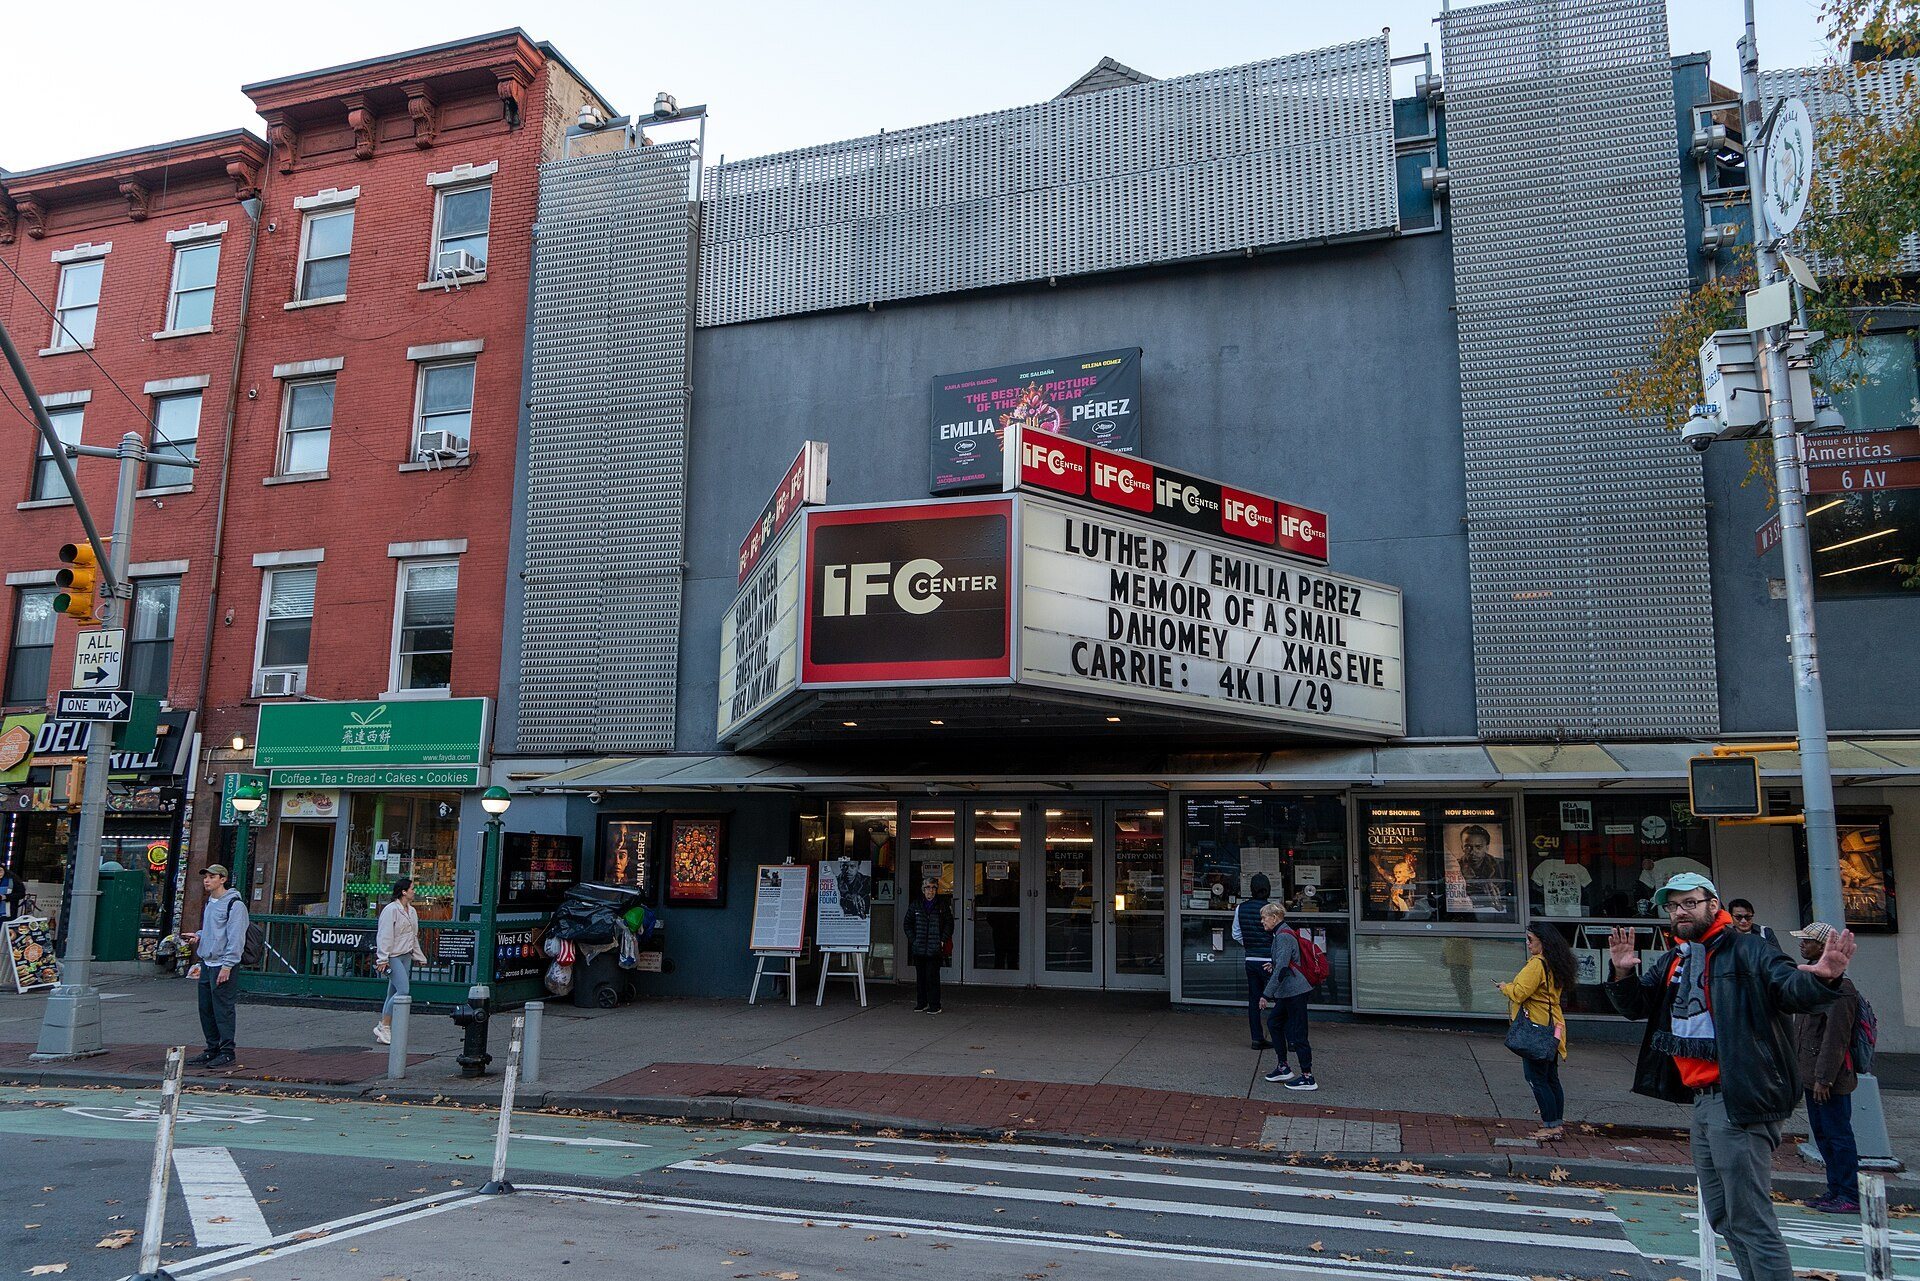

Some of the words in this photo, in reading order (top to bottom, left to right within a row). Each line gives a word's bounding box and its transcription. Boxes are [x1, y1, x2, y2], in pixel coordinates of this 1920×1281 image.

[1082, 362, 1102, 370] SELENA
[1030, 369, 1055, 378] SALDAÑA
[944, 383, 961, 391] KARLA
[976, 378, 998, 387] GASCÓN
[991, 387, 1022, 399] BEST
[1045, 376, 1097, 392] PICTURE
[976, 404, 990, 412] OF
[994, 399, 1018, 409] THE
[1695, 403, 1717, 414] NYPD
[940, 418, 995, 440] EMILIA
[1072, 398, 1130, 422] PÉREZ
[1806, 439, 1840, 447] Avenue
[1842, 437, 1851, 445] of
[1808, 444, 1892, 461] Americas
[1054, 459, 1083, 473] CENTER
[1124, 477, 1150, 491] CENTER
[1841, 470, 1853, 489] 6
[1863, 469, 1886, 488] Av
[1189, 496, 1219, 511] CENTER
[1250, 512, 1273, 525] CENTER
[1304, 527, 1326, 539] CENTER
[1761, 530, 1768, 550] W
[1769, 527, 1773, 545] 3
[1065, 518, 1168, 574] LUTHER
[1179, 549, 1197, 578] /
[1210, 554, 1291, 602] EMILIA
[915, 575, 997, 594] CENTER
[736, 586, 758, 633] SABBATH
[759, 557, 778, 606] QUEEN
[1110, 568, 1211, 620] MEMOIR
[1225, 595, 1254, 628] OF
[1263, 603, 1278, 633] A
[1285, 607, 1346, 647] SNAIL
[736, 608, 764, 663] PORCELAIN
[764, 592, 778, 633] WAR
[87, 635, 112, 649] ALL
[1108, 607, 1228, 660] DAHOMEY
[1246, 637, 1262, 664] /
[78, 651, 119, 664] TRAFFIC
[735, 651, 754, 691] ERNEST
[754, 635, 769, 674] COLE
[746, 678, 761, 713] LOOK
[761, 658, 780, 701] AWAY
[67, 700, 88, 711] ONE
[98, 700, 120, 711] WAY
[422, 753, 471, 762] www.fayda.com
[279, 773, 311, 784] Coffee
[320, 773, 337, 784] Tea
[346, 772, 376, 784] Bread
[385, 772, 417, 784] Cakes
[426, 772, 468, 784] Cookies
[1368, 827, 1415, 836] SABBATH
[637, 831, 646, 861] PÉREZ
[1368, 835, 1404, 845] QUEEN
[376, 844, 385, 855] A
[820, 882, 835, 891] COLE:
[879, 881, 893, 895] A
[819, 896, 838, 904] FOUND
[1847, 895, 1877, 904] ELAIN
[311, 929, 362, 947] Subway
[498, 933, 516, 945] West
[517, 934, 523, 943] 4
[524, 932, 532, 943] St
[498, 948, 504, 957] A
[506, 948, 512, 957] C
[515, 947, 520, 955] E
[505, 970, 520, 978] across
[524, 968, 539, 976] Avenue
